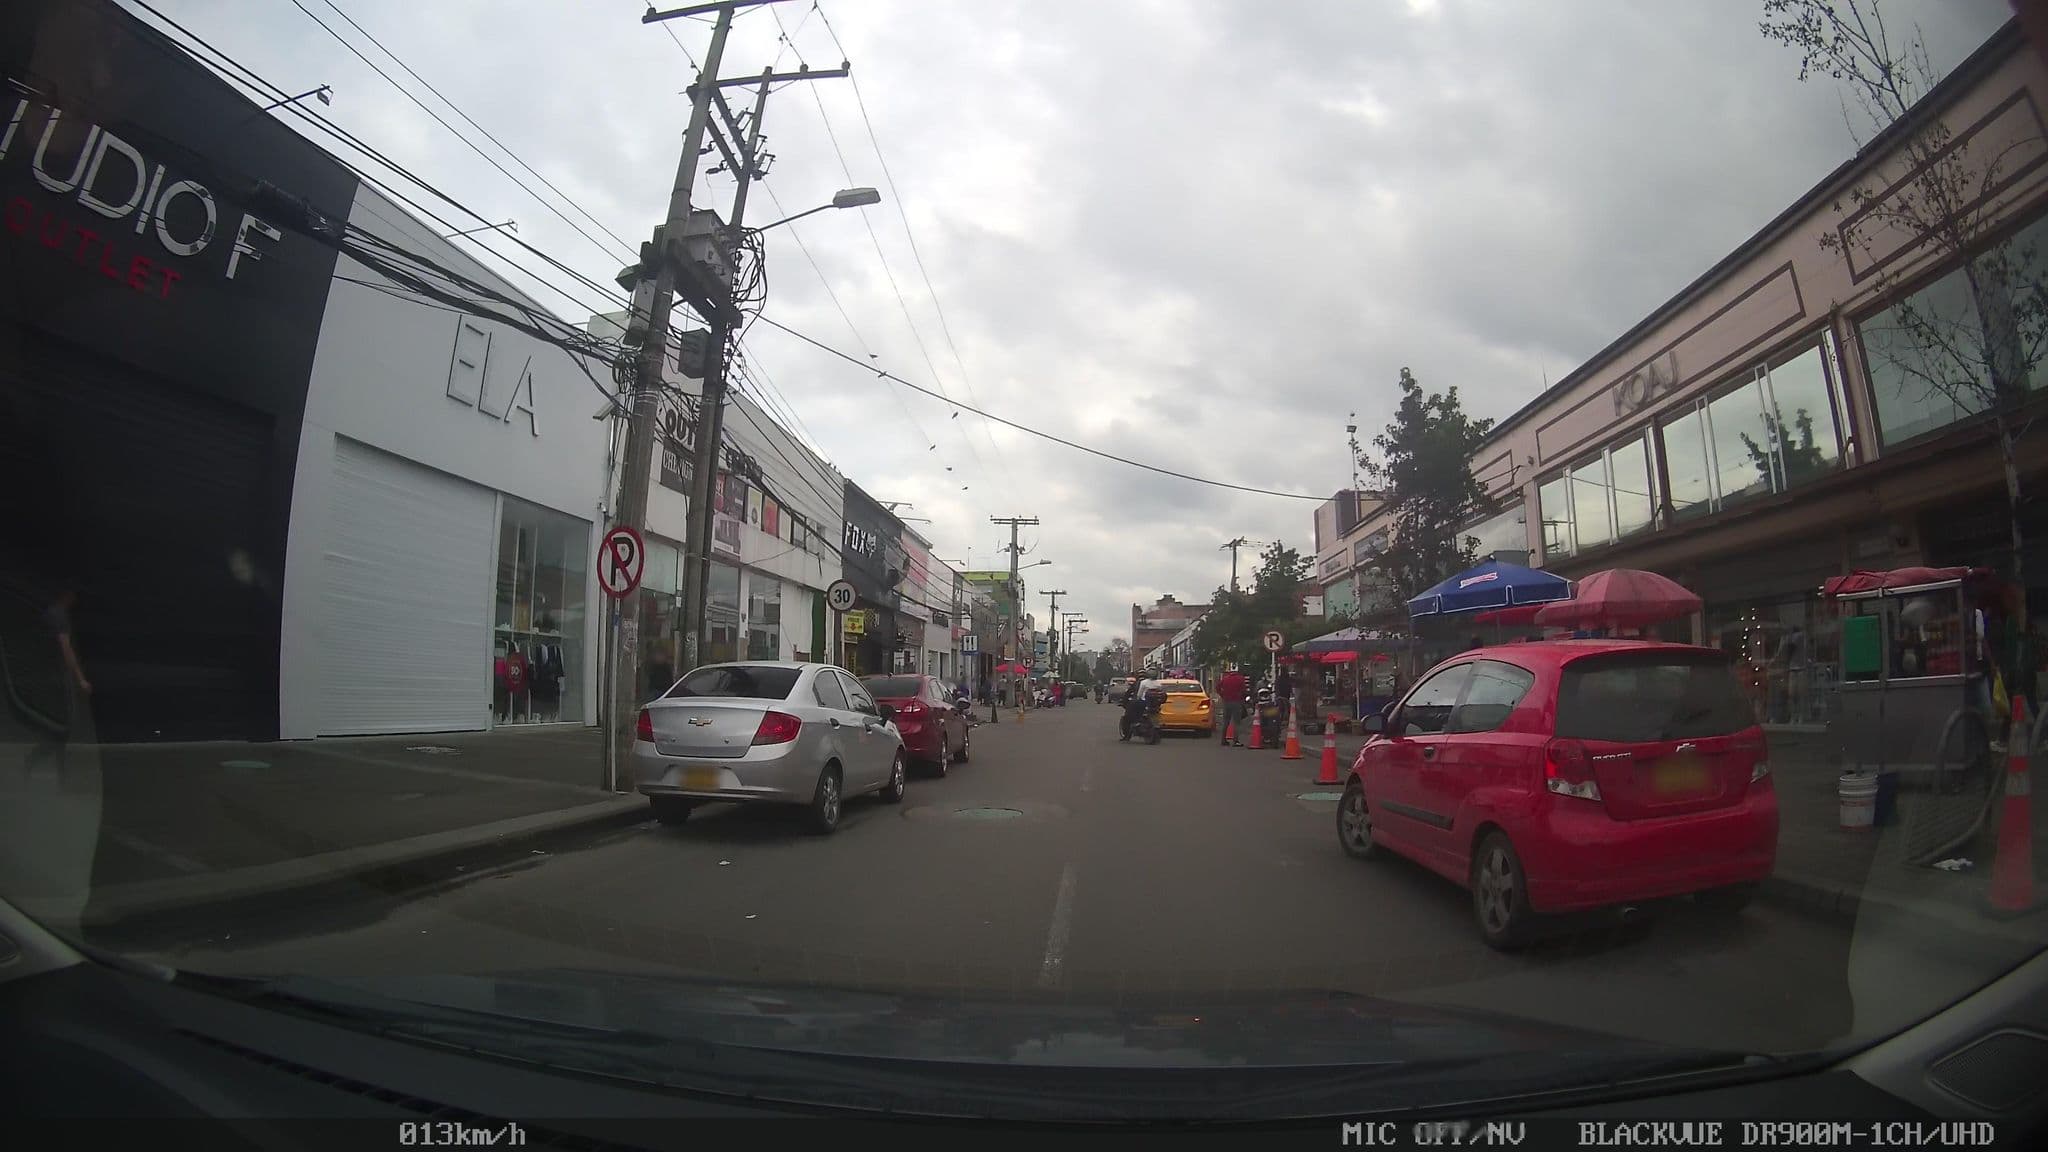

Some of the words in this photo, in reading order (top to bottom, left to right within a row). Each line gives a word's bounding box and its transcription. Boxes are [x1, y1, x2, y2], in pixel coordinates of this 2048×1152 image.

[4, 196, 182, 298] OUTLET
[225, 213, 282, 280] F
[446, 314, 539, 438] ELA
[1612, 350, 1679, 418] KOAJ
[610, 536, 635, 586] P
[844, 521, 866, 555] FOX
[834, 588, 851, 604] 30
